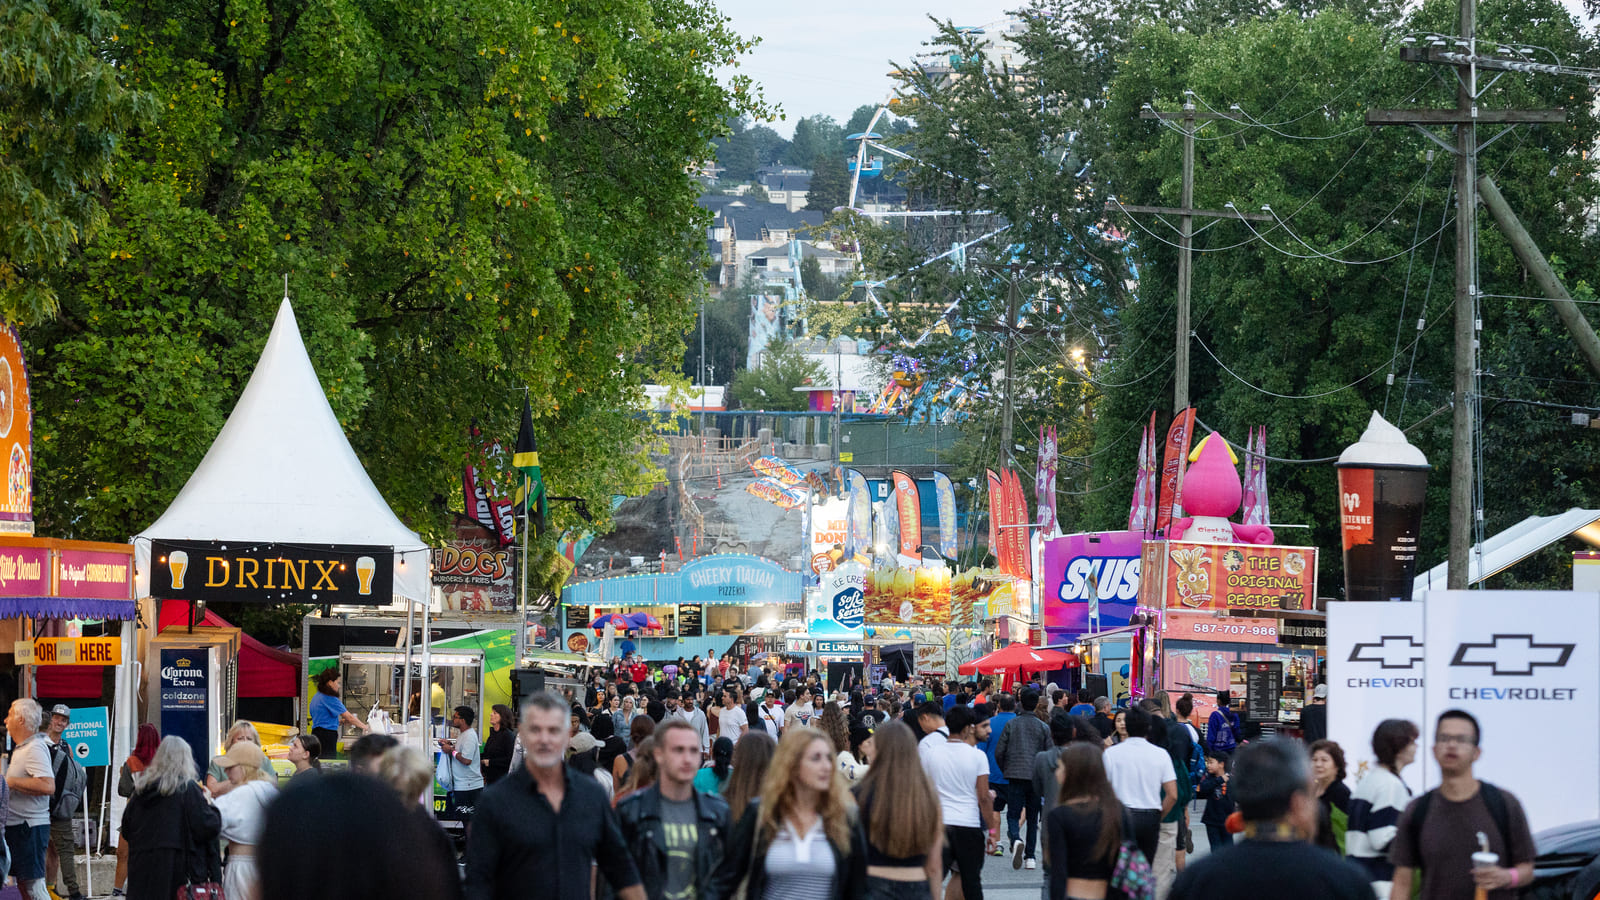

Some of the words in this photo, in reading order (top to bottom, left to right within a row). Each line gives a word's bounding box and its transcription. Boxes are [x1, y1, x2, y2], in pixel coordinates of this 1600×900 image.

[17, 554, 41, 580] Donuts
[440, 547, 507, 580] DOGS
[1248, 556, 1280, 571] THE
[204, 556, 339, 591] DRINX
[433, 575, 463, 583] BURGERS
[690, 567, 733, 588] CHEEKY
[736, 565, 775, 589] ITALIAN
[832, 577, 845, 589] ICE
[1227, 574, 1303, 590] ORIGINAL
[718, 586, 746, 596] PIZZERIA
[838, 591, 864, 609] Soft
[1193, 623, 1277, 636] 587-707-986
[80, 643, 113, 661] HERE
[818, 642, 831, 651] ICE
[832, 643, 859, 652] CREAM
[161, 666, 205, 681] Corona
[172, 677, 196, 687] Extra
[162, 691, 205, 700] coldzone
[1449, 687, 1577, 700] CHEVROLET
[65, 720, 104, 731] DITIONAL
[66, 730, 98, 739] SEATING
